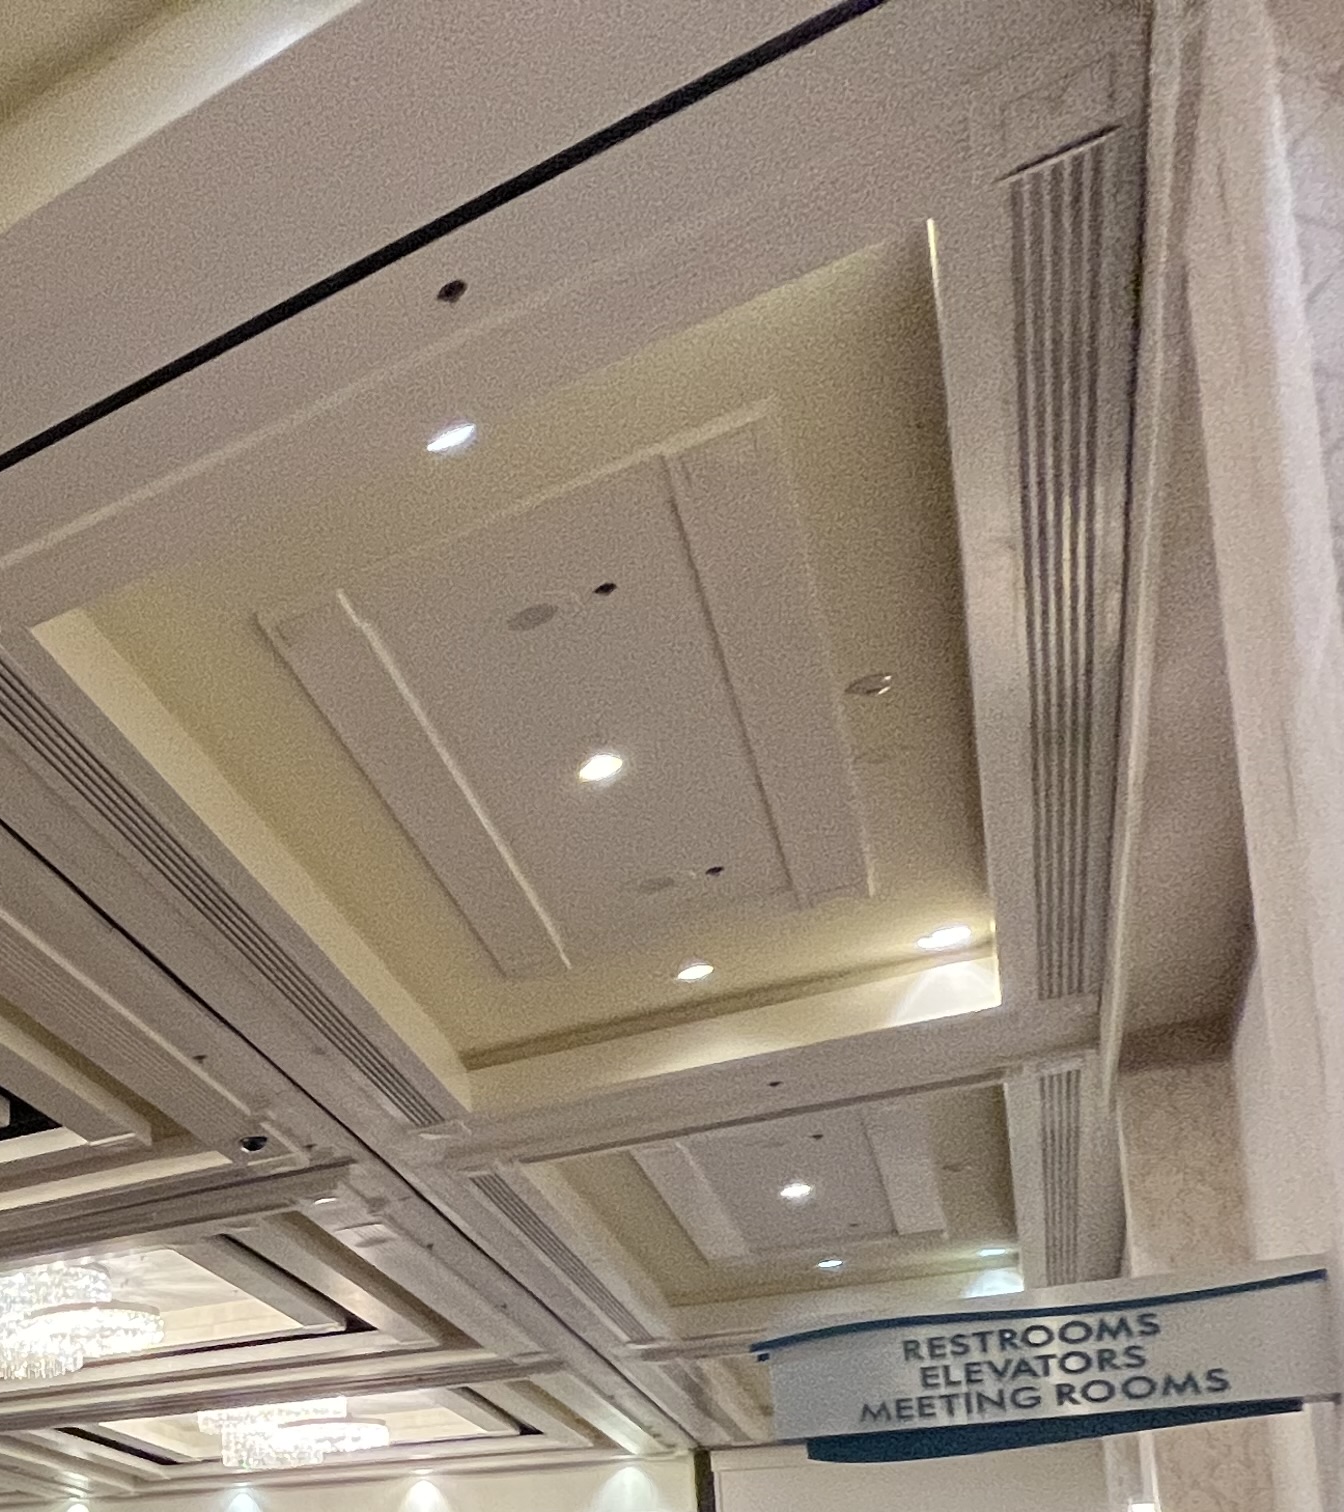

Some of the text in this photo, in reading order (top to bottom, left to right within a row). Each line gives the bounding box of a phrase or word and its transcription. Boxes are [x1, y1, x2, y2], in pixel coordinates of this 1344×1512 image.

[902, 1312, 1162, 1363] RESTROOMS
[919, 1345, 1148, 1389] ELEVATORS
[858, 1368, 1231, 1424] MEETING ROOMS
